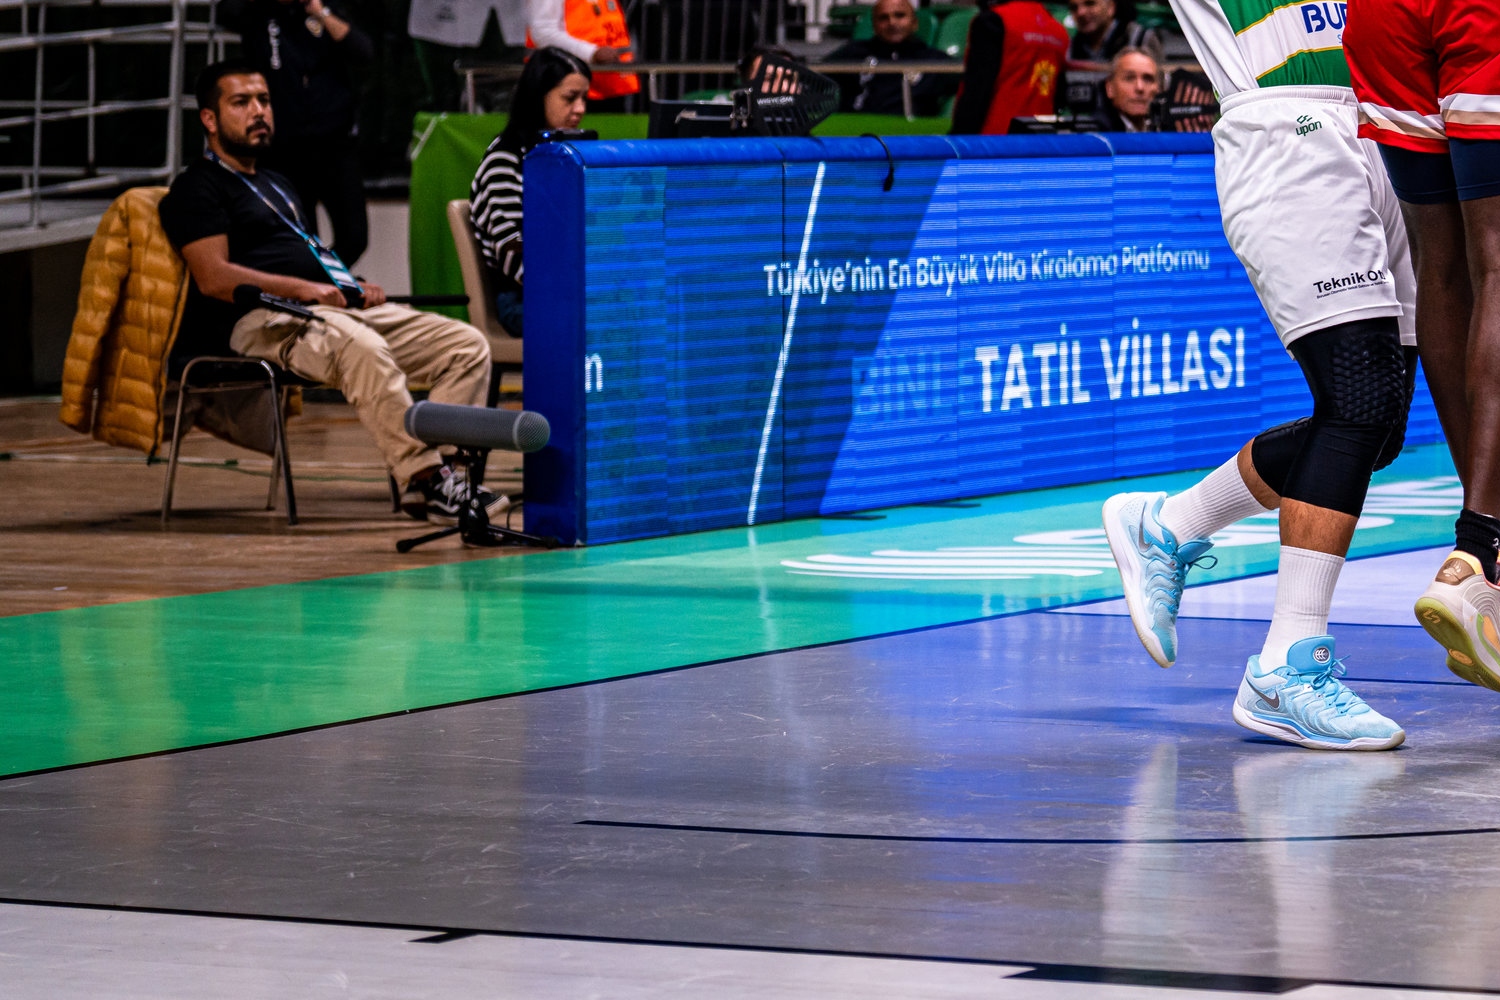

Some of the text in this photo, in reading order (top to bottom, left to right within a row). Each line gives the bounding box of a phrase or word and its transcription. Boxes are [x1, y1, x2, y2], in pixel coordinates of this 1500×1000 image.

[1295, 120, 1322, 137] upon
[889, 258, 911, 289] En
[915, 252, 979, 297] Büyük
[983, 249, 1026, 284] Villa
[1031, 244, 1118, 280] Kiralama
[1121, 242, 1211, 274] Platformu
[1313, 272, 1365, 294] Teknik
[974, 323, 1091, 414] TATİL
[1100, 316, 1246, 401] VİLLASI
